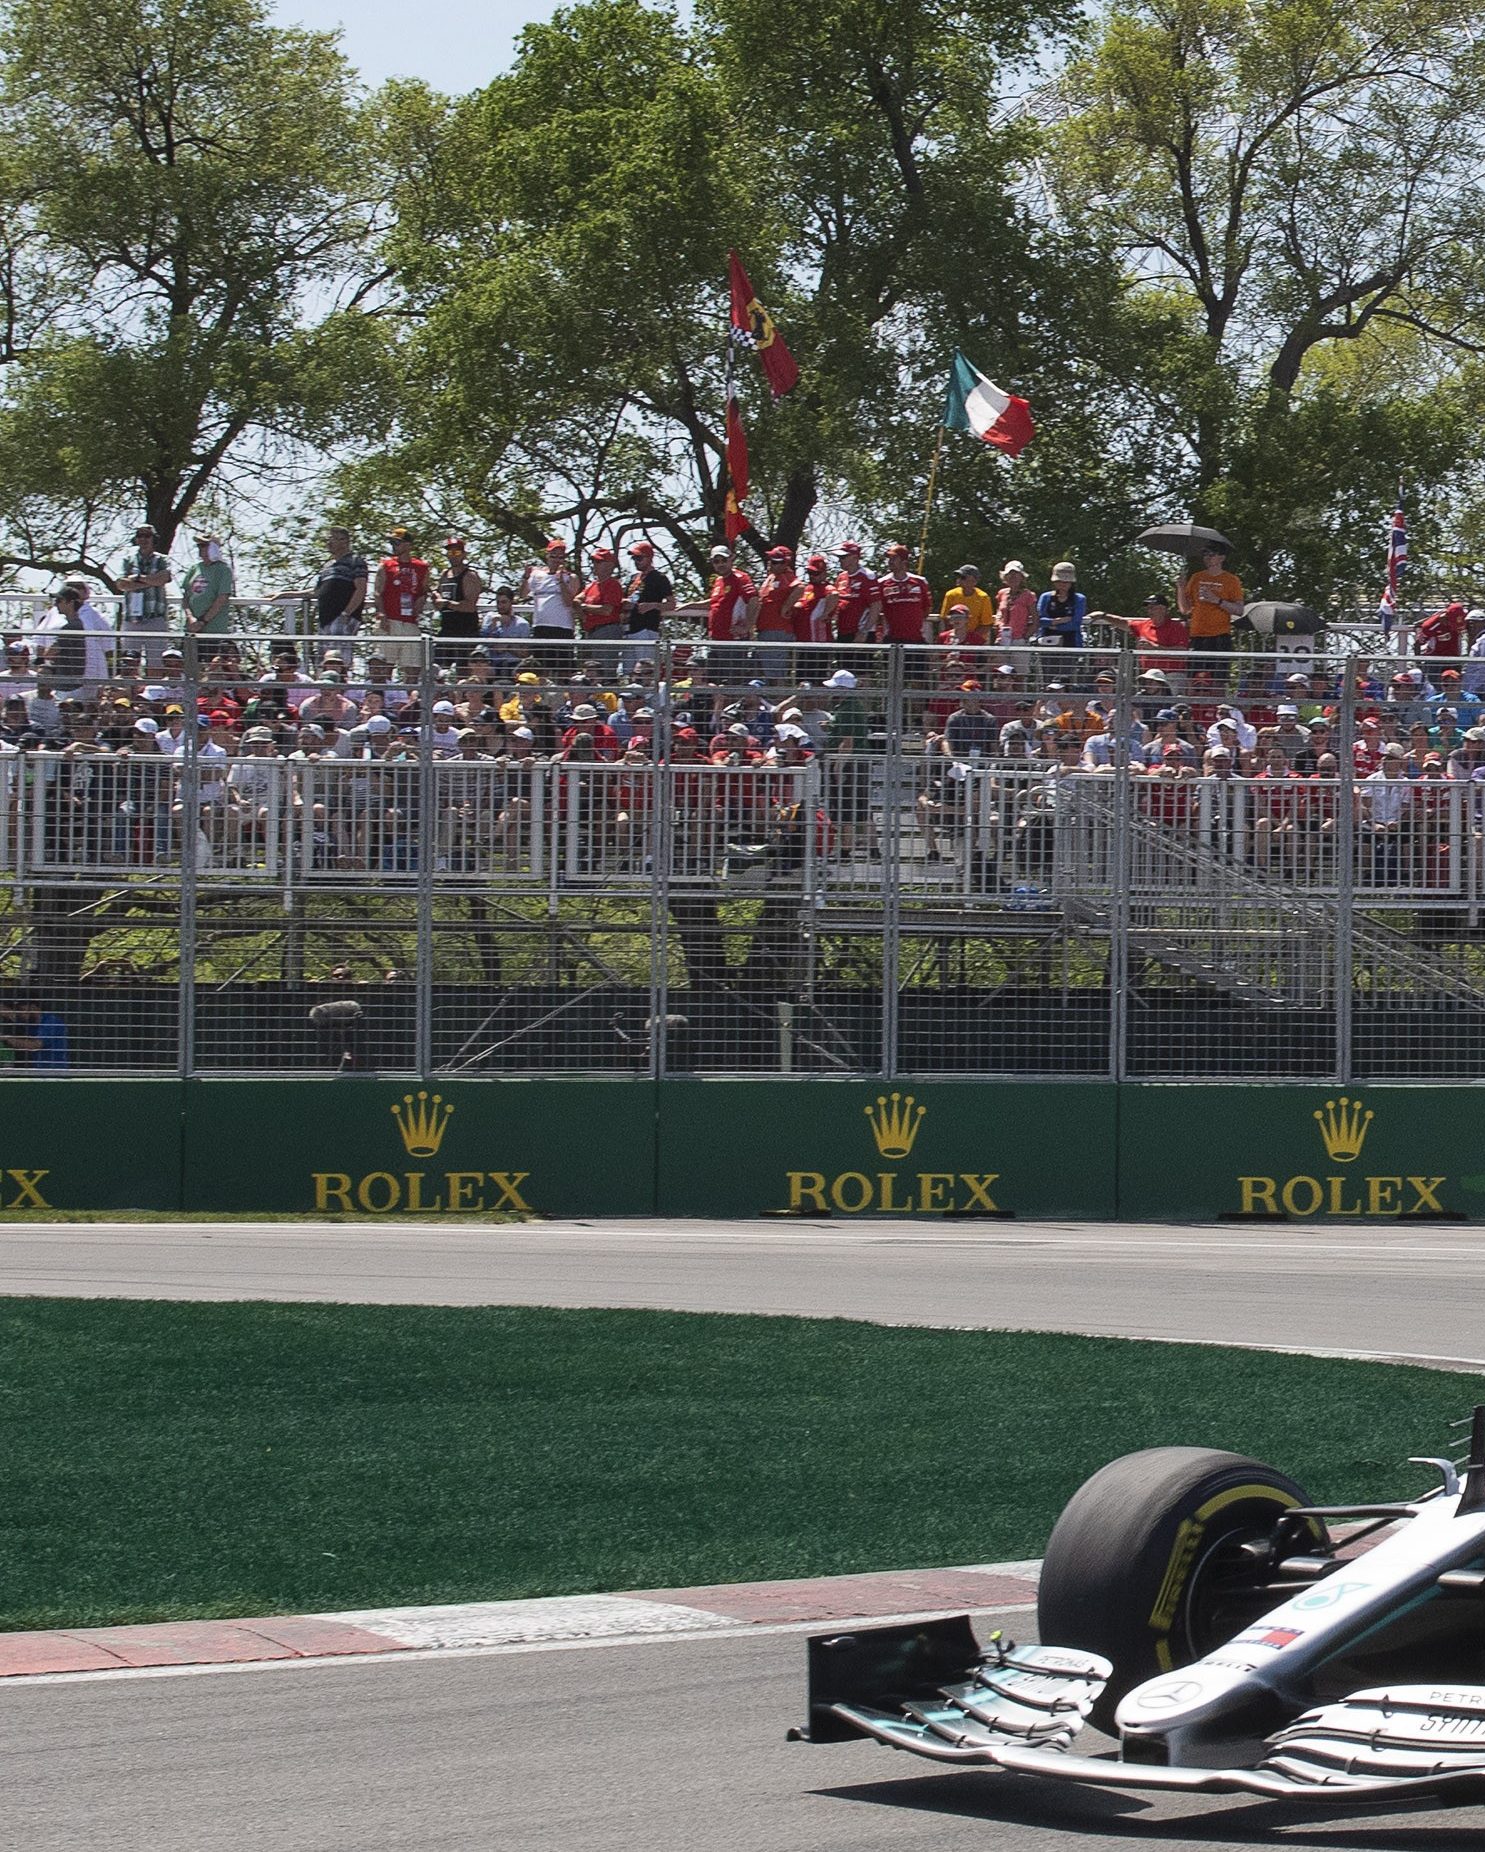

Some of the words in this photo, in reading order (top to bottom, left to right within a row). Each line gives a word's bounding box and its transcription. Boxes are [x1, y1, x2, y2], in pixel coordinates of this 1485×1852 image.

[312, 1171, 533, 1212] ROLEX
[786, 1172, 1000, 1211] ROLEX
[1237, 1177, 1447, 1215] ROLEX
